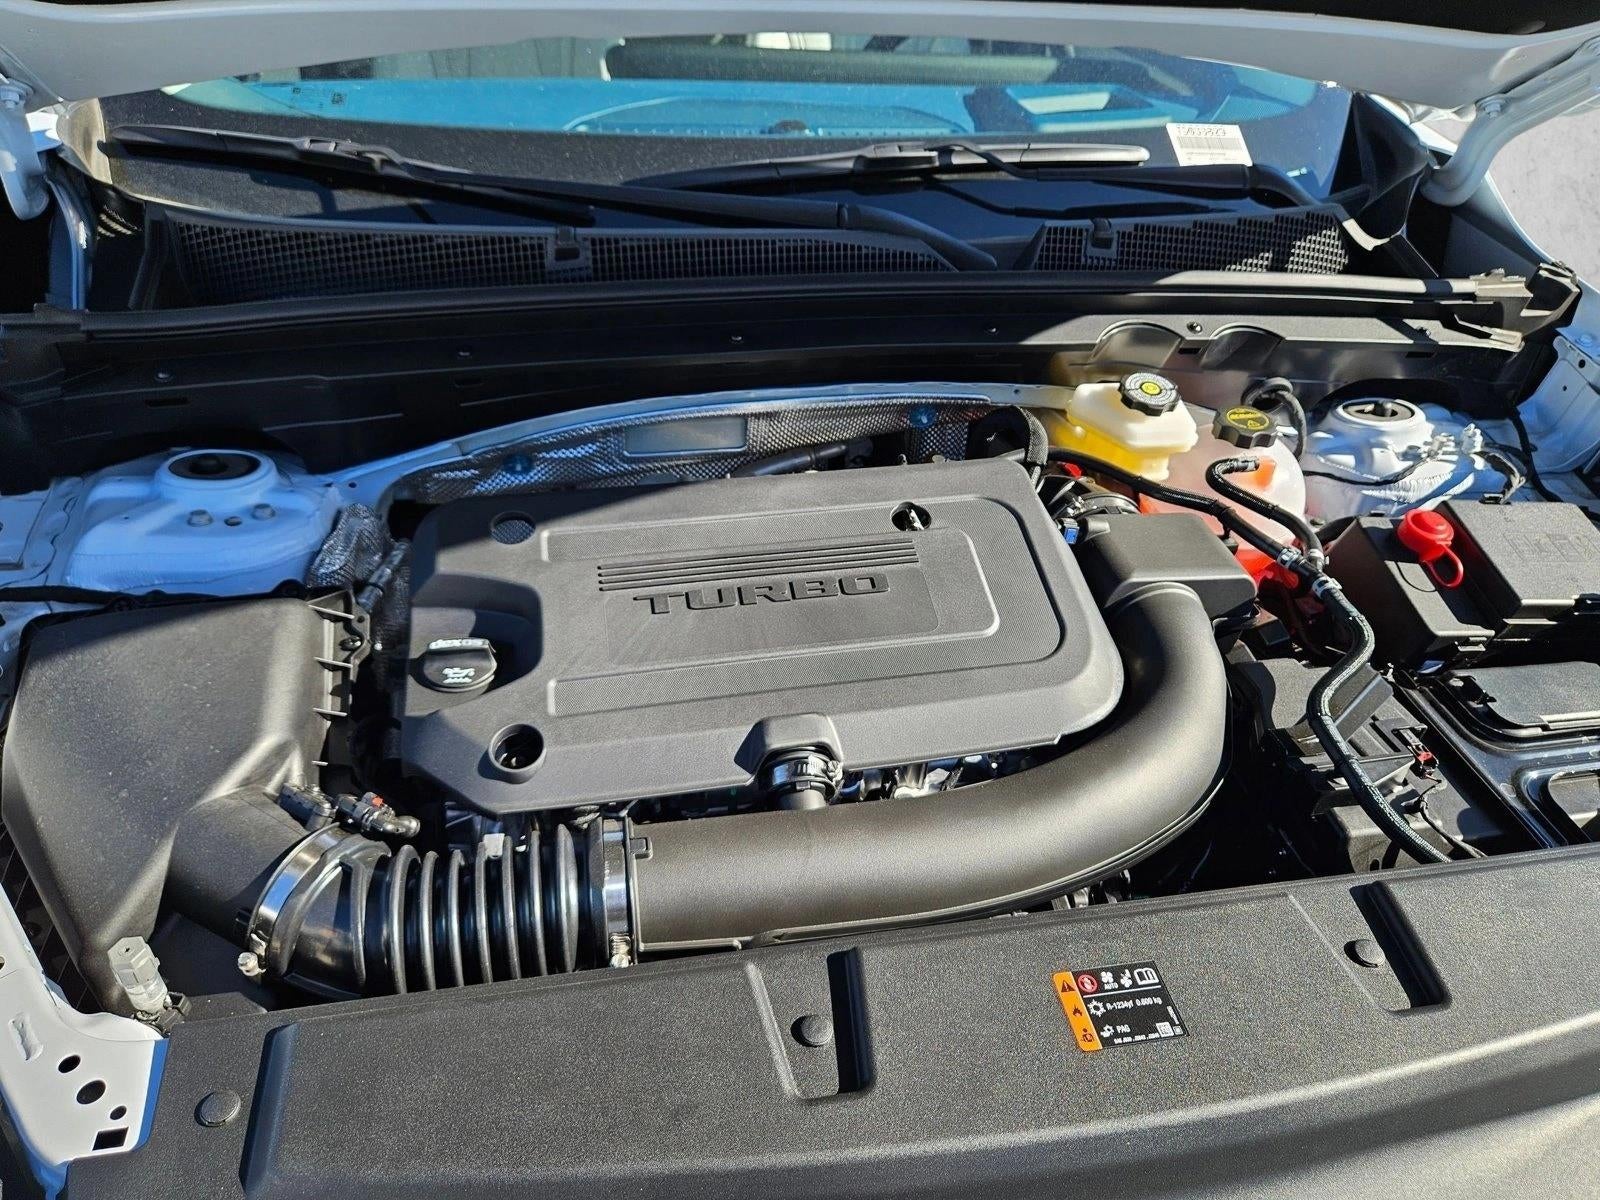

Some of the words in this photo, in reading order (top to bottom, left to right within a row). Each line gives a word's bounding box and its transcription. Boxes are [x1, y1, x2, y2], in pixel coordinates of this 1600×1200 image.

[633, 573, 890, 615] TURBO
[1152, 996, 1163, 1005] kg
[1116, 1024, 1131, 1034] PAG
